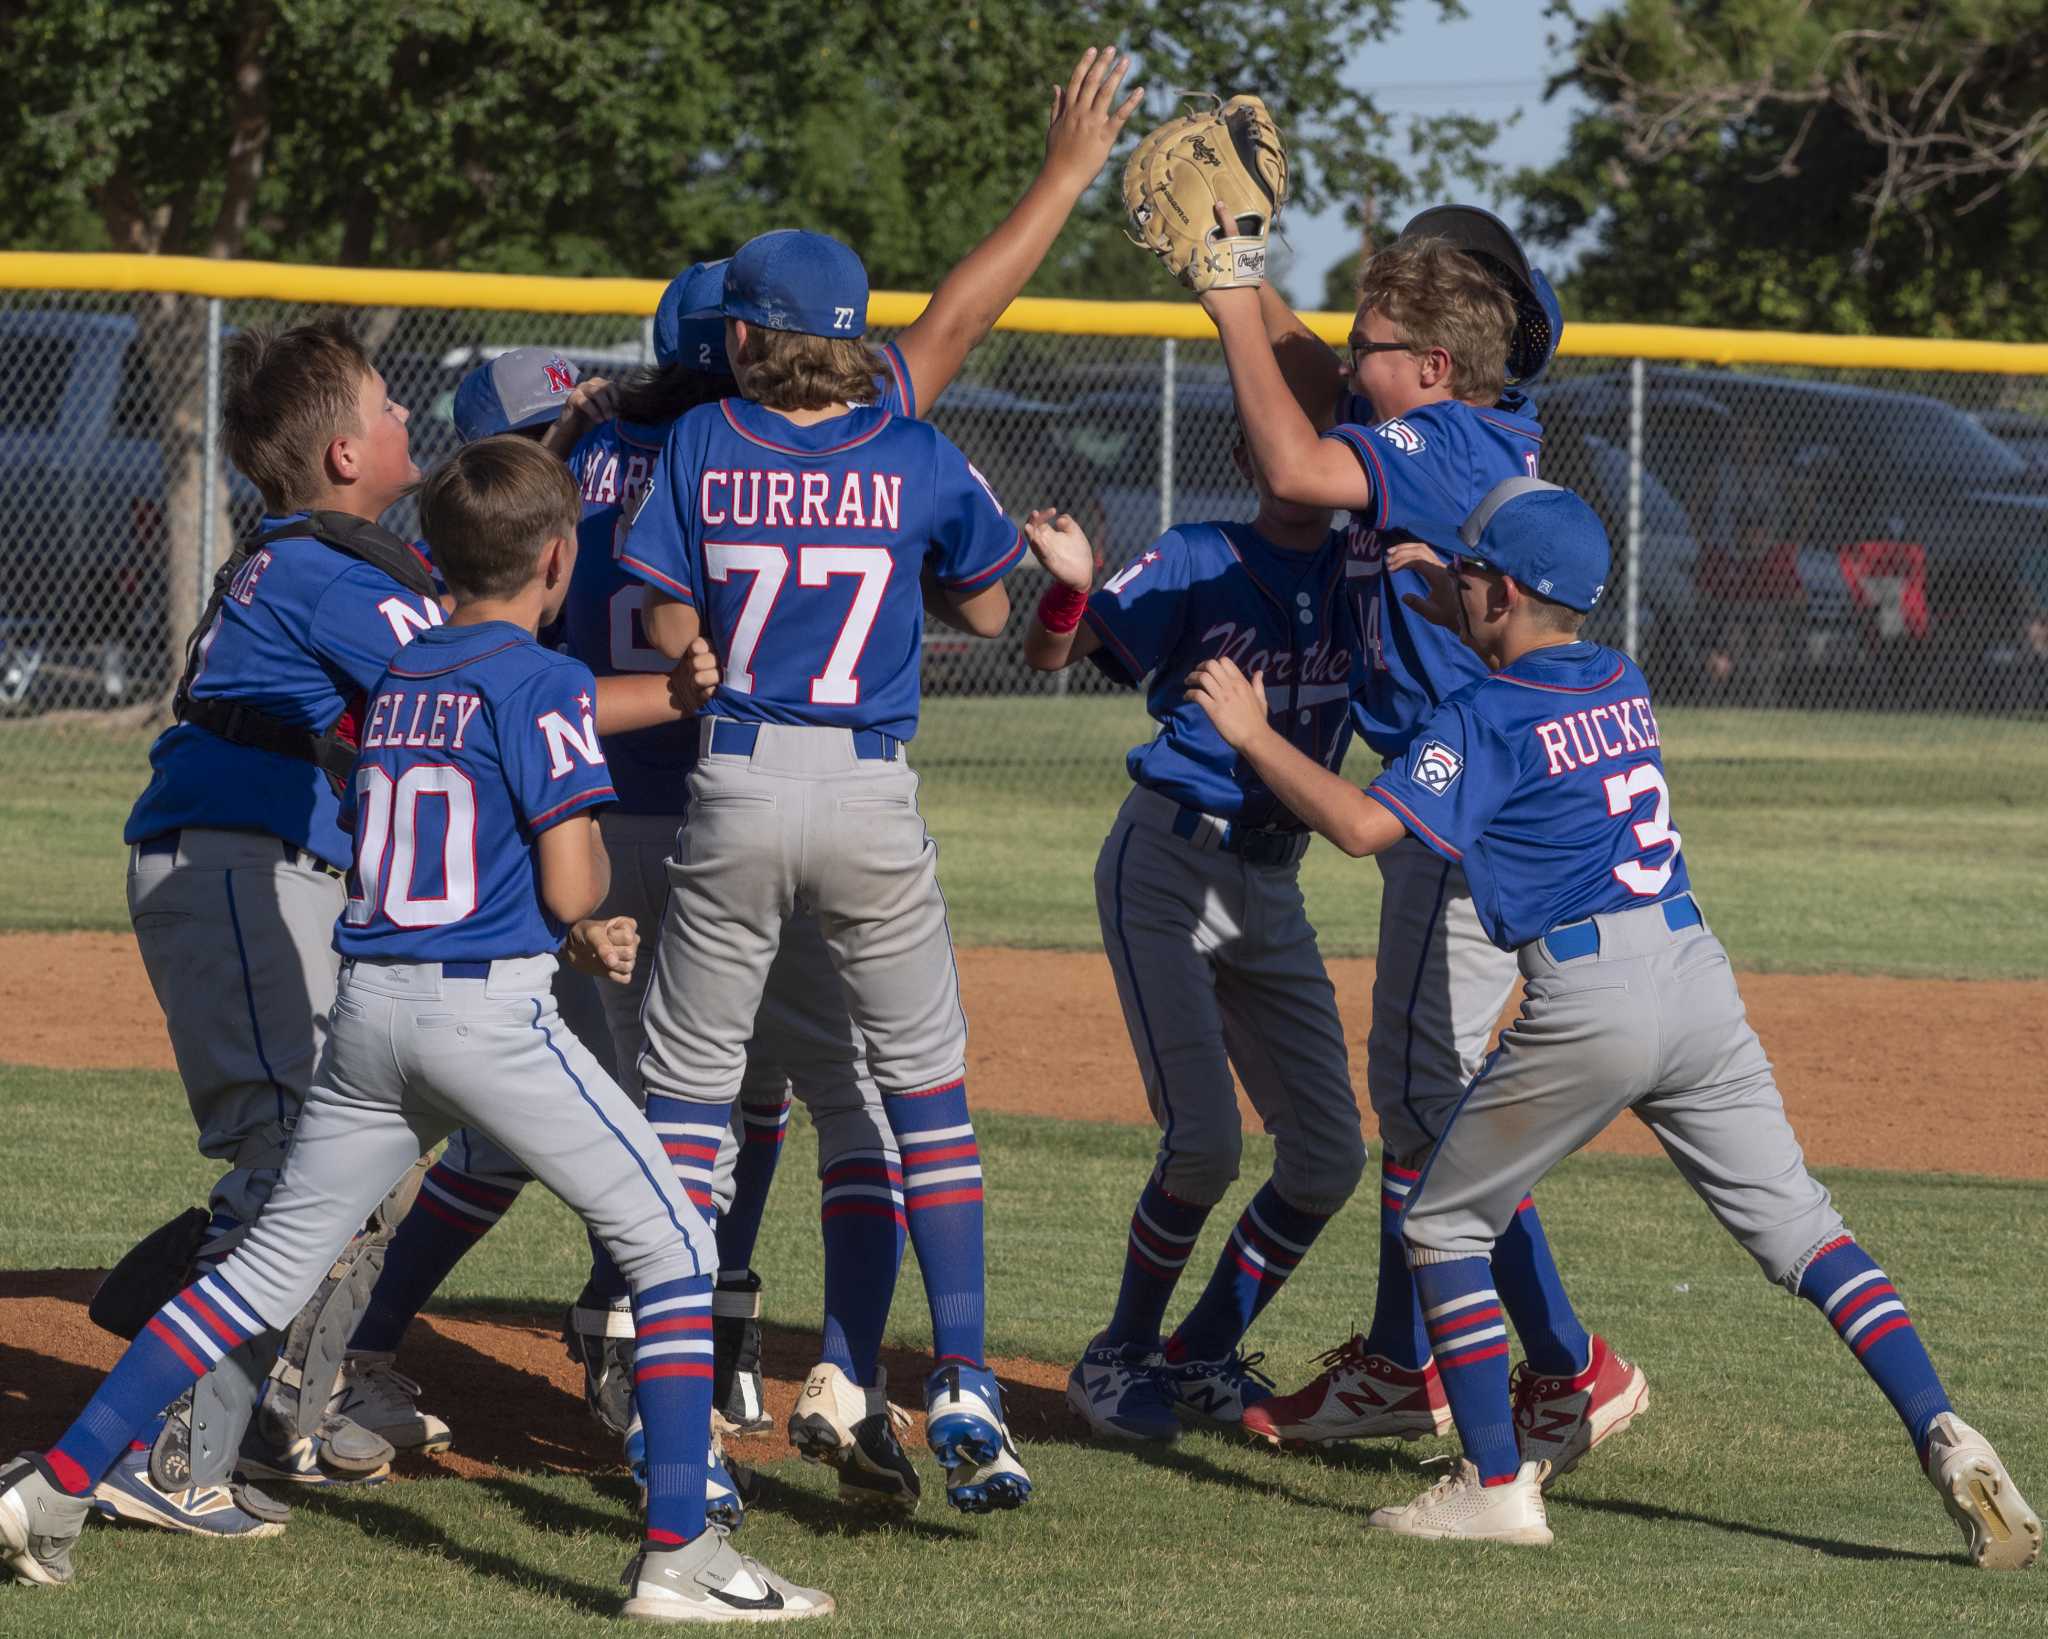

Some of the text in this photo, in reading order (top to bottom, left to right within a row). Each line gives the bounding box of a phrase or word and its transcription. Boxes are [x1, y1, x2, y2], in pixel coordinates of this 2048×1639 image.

[834, 306, 855, 330] 77
[542, 361, 576, 394] N
[699, 343, 712, 364] 2
[580, 447, 657, 506] MAR
[701, 470, 901, 531] CURRAN
[376, 596, 444, 647] N
[703, 541, 895, 705] 77
[1591, 585, 1604, 604] 3
[363, 691, 482, 750] ELLEY
[536, 711, 606, 781] N
[1536, 697, 1661, 776] RUCKE
[1602, 763, 1682, 896] 3
